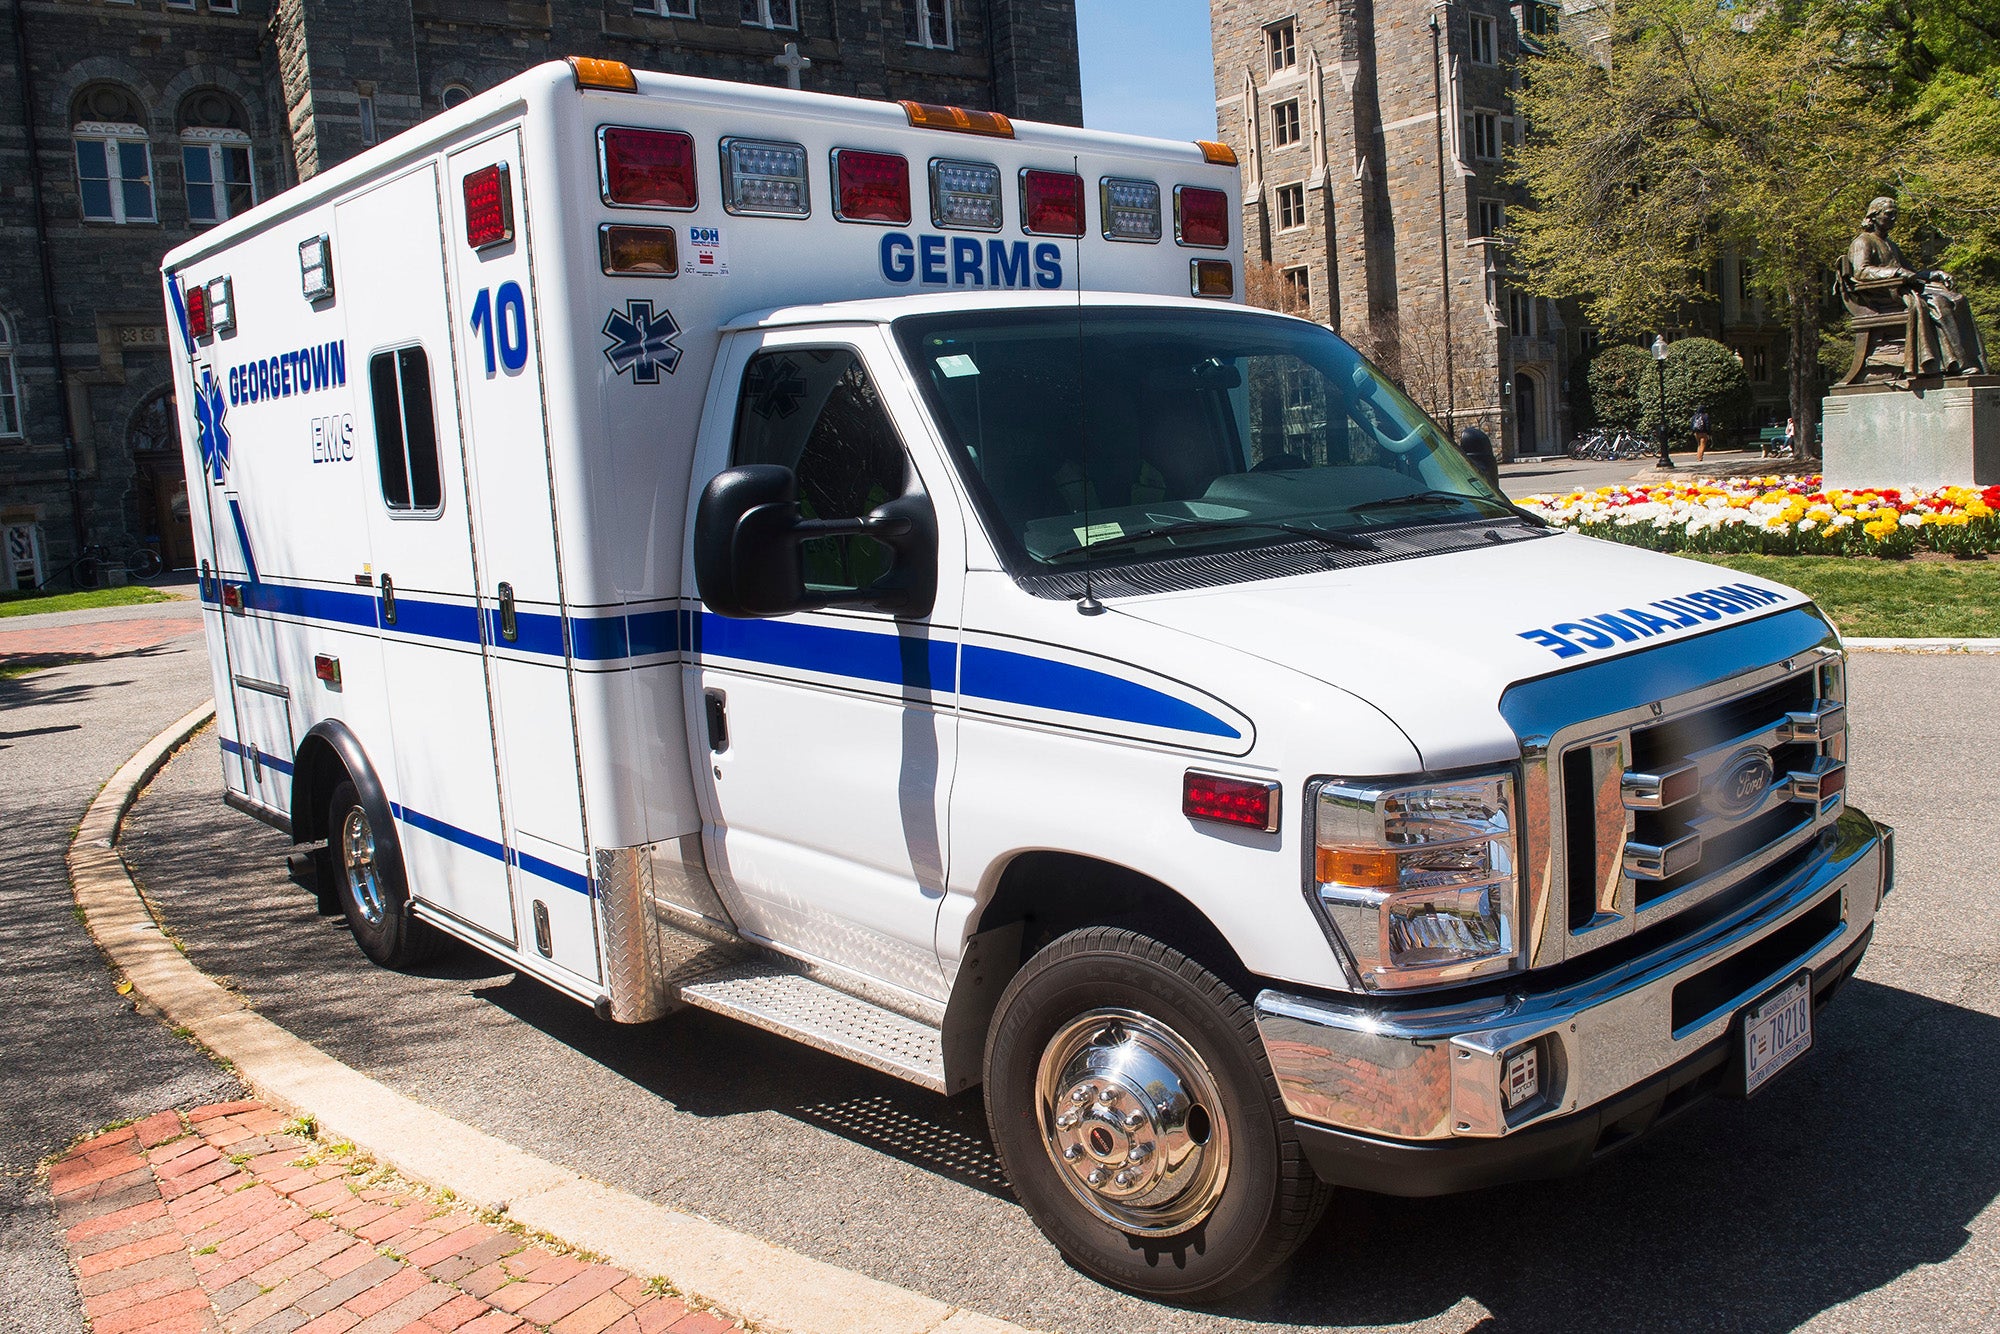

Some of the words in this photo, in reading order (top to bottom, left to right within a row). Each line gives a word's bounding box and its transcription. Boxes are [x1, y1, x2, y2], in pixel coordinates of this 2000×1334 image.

[690, 228, 719, 241] DOH
[878, 231, 1063, 290] GERMS
[469, 279, 529, 380] 10
[229, 339, 346, 407] GEORGETOWN
[311, 413, 355, 463] EMS
[1737, 767, 1765, 799] Ford
[1769, 997, 1806, 1056] 78218
